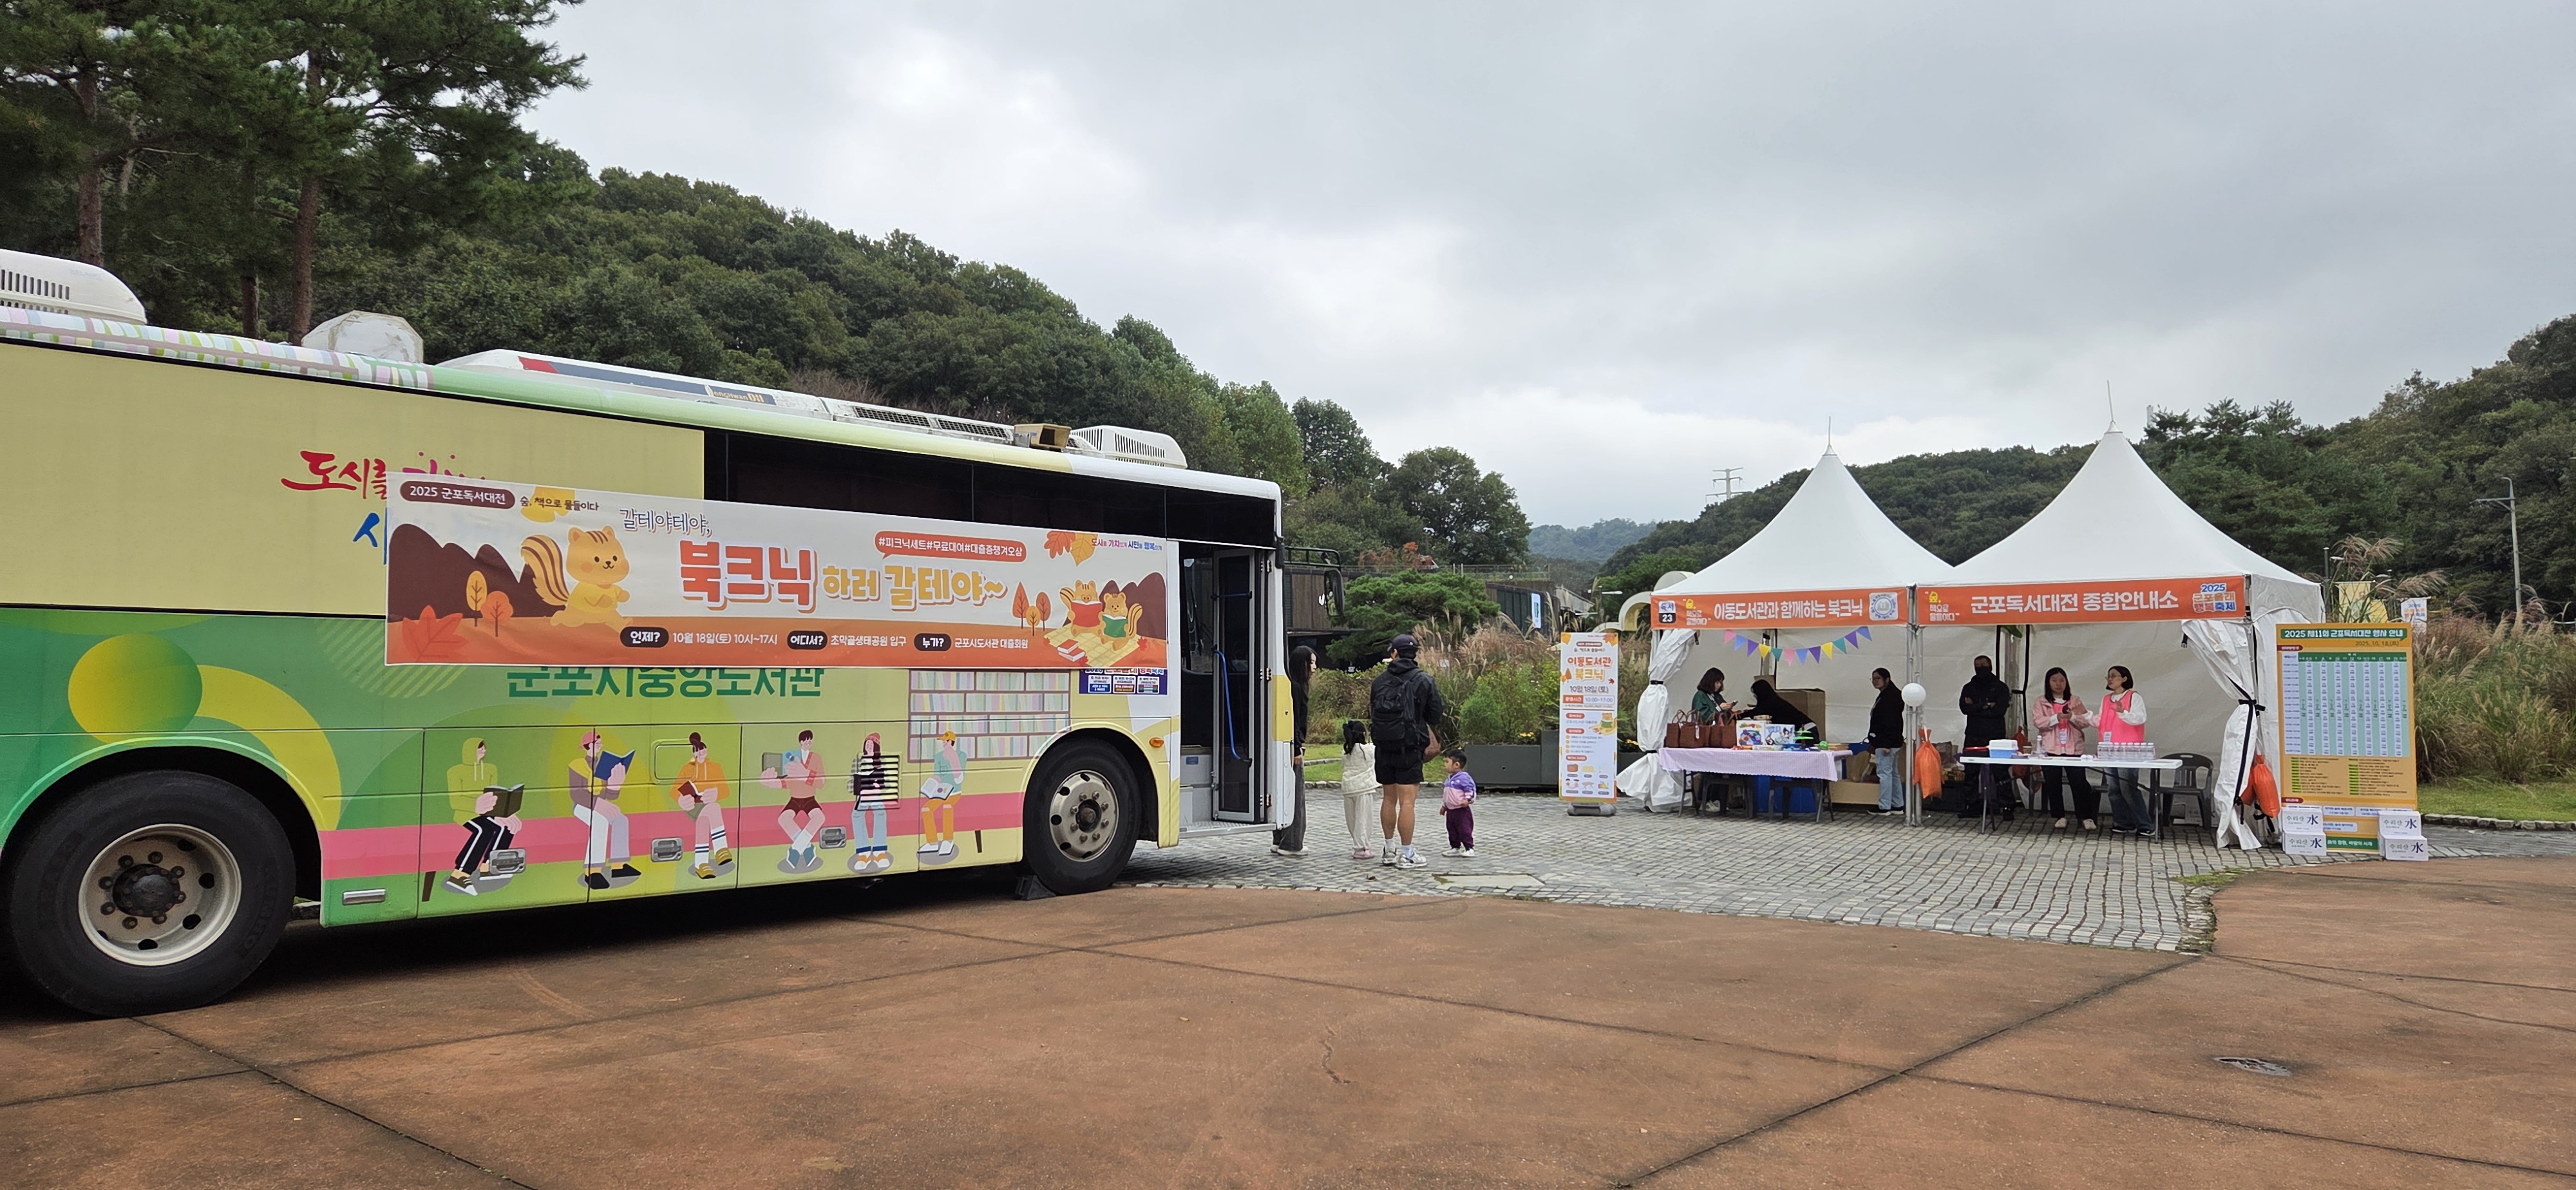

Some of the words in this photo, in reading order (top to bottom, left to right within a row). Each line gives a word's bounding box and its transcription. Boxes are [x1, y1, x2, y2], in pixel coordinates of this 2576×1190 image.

[281, 450, 386, 500] 도시를
[410, 486, 438, 497] 2025
[442, 487, 506, 505] 군포독서대전
[520, 496, 532, 507] 숲,
[534, 496, 562, 507] 책으로
[564, 498, 600, 511] 물들이다
[620, 508, 712, 535] 갈테야테야,
[679, 540, 811, 606] 북크닉
[822, 565, 877, 598] 하러
[884, 565, 1004, 607] 갈테야~
[2201, 583, 2226, 592] 2025
[1971, 593, 2079, 614] 군포독서대전
[2082, 590, 2179, 611] 종합안내소
[1714, 601, 1779, 620] 이동도서관과
[1781, 600, 1826, 619] 함께하는
[1828, 598, 1863, 618] 북크닉
[1662, 614, 1673, 623] 23
[630, 630, 660, 645] 언제?
[673, 632, 693, 644] 10월
[696, 632, 732, 645] 18일(토)
[734, 633, 778, 645] 10시~17시
[790, 635, 824, 646] 어디서?
[831, 635, 888, 647] 초막골생태공원
[890, 635, 907, 647] 입구
[922, 637, 945, 648] 누가?
[954, 638, 999, 648] 군포시도서관
[1000, 639, 1028, 649] 대출회원
[2284, 630, 2306, 638] 2025
[1567, 657, 1611, 667] 이동도서관
[1575, 668, 1604, 681] 북크닉
[2306, 814, 2319, 826] 水
[2404, 818, 2418, 829] 水
[2309, 837, 2323, 849] 水
[2410, 842, 2424, 854] 水
